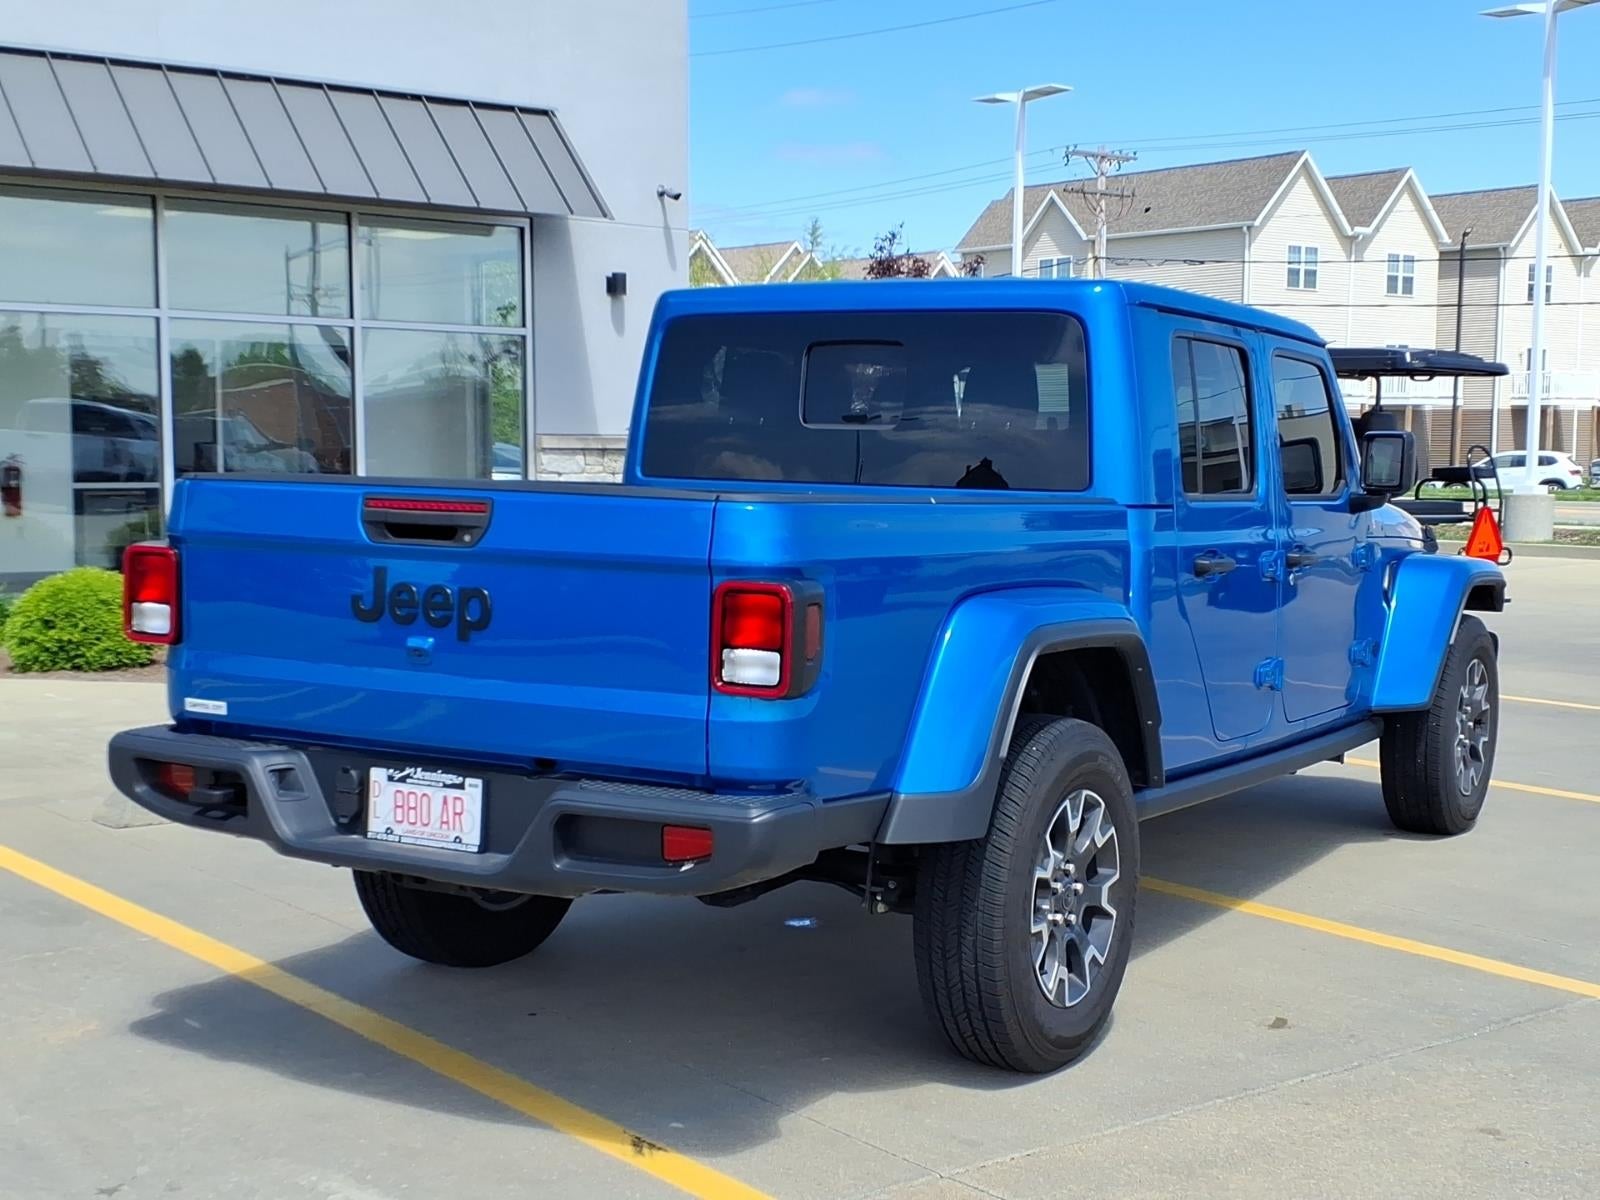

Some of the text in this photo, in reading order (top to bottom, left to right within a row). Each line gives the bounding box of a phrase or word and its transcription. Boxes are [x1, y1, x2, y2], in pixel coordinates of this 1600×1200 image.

[350, 566, 492, 642] Jeep
[394, 790, 464, 832] 880 AR
